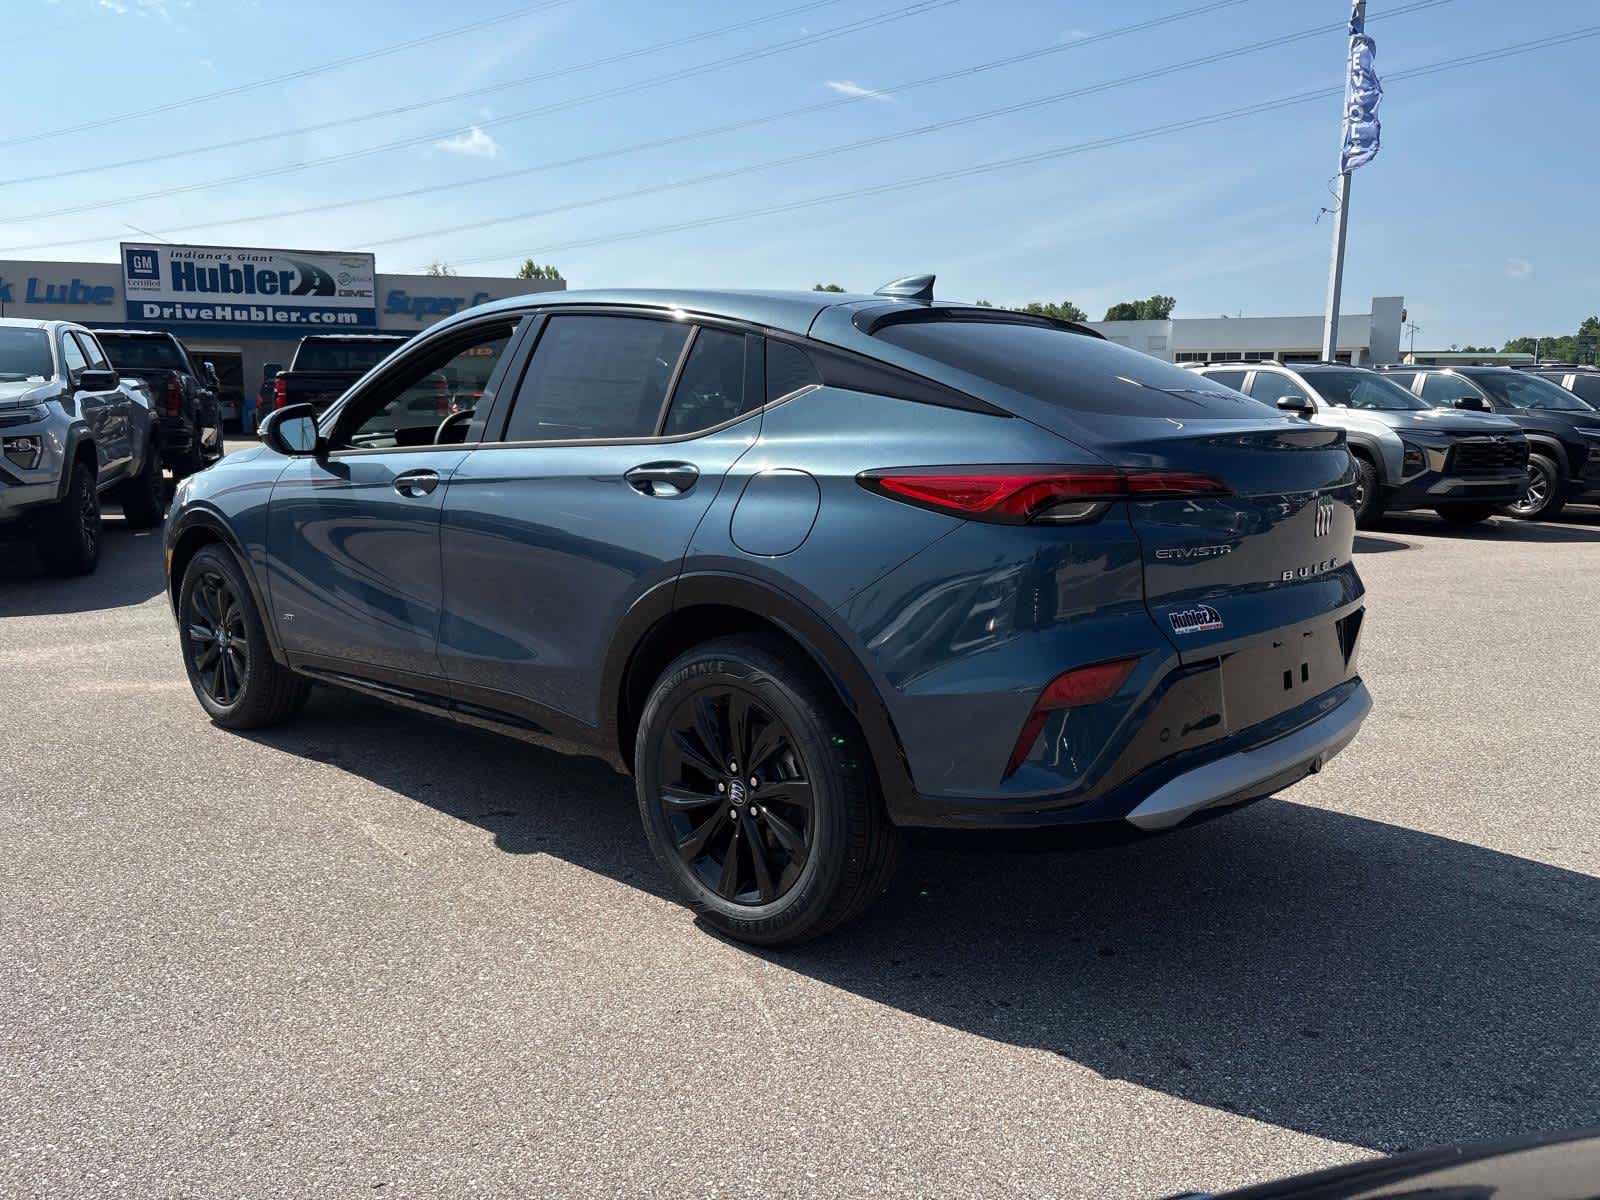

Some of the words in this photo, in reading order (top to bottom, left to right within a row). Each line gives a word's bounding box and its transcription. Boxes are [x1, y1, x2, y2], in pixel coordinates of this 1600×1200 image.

[133, 255, 153, 270] GM
[170, 250, 233, 261] Indiana's
[237, 254, 274, 263] Giant
[171, 261, 296, 296] Hubler
[24, 277, 114, 305] Lube
[338, 289, 373, 298] GMC
[142, 303, 359, 325] DriveHubler.com
[1155, 544, 1232, 560] ENVISTA
[1280, 557, 1338, 582] BUICK
[1168, 610, 1208, 630] Hubler
